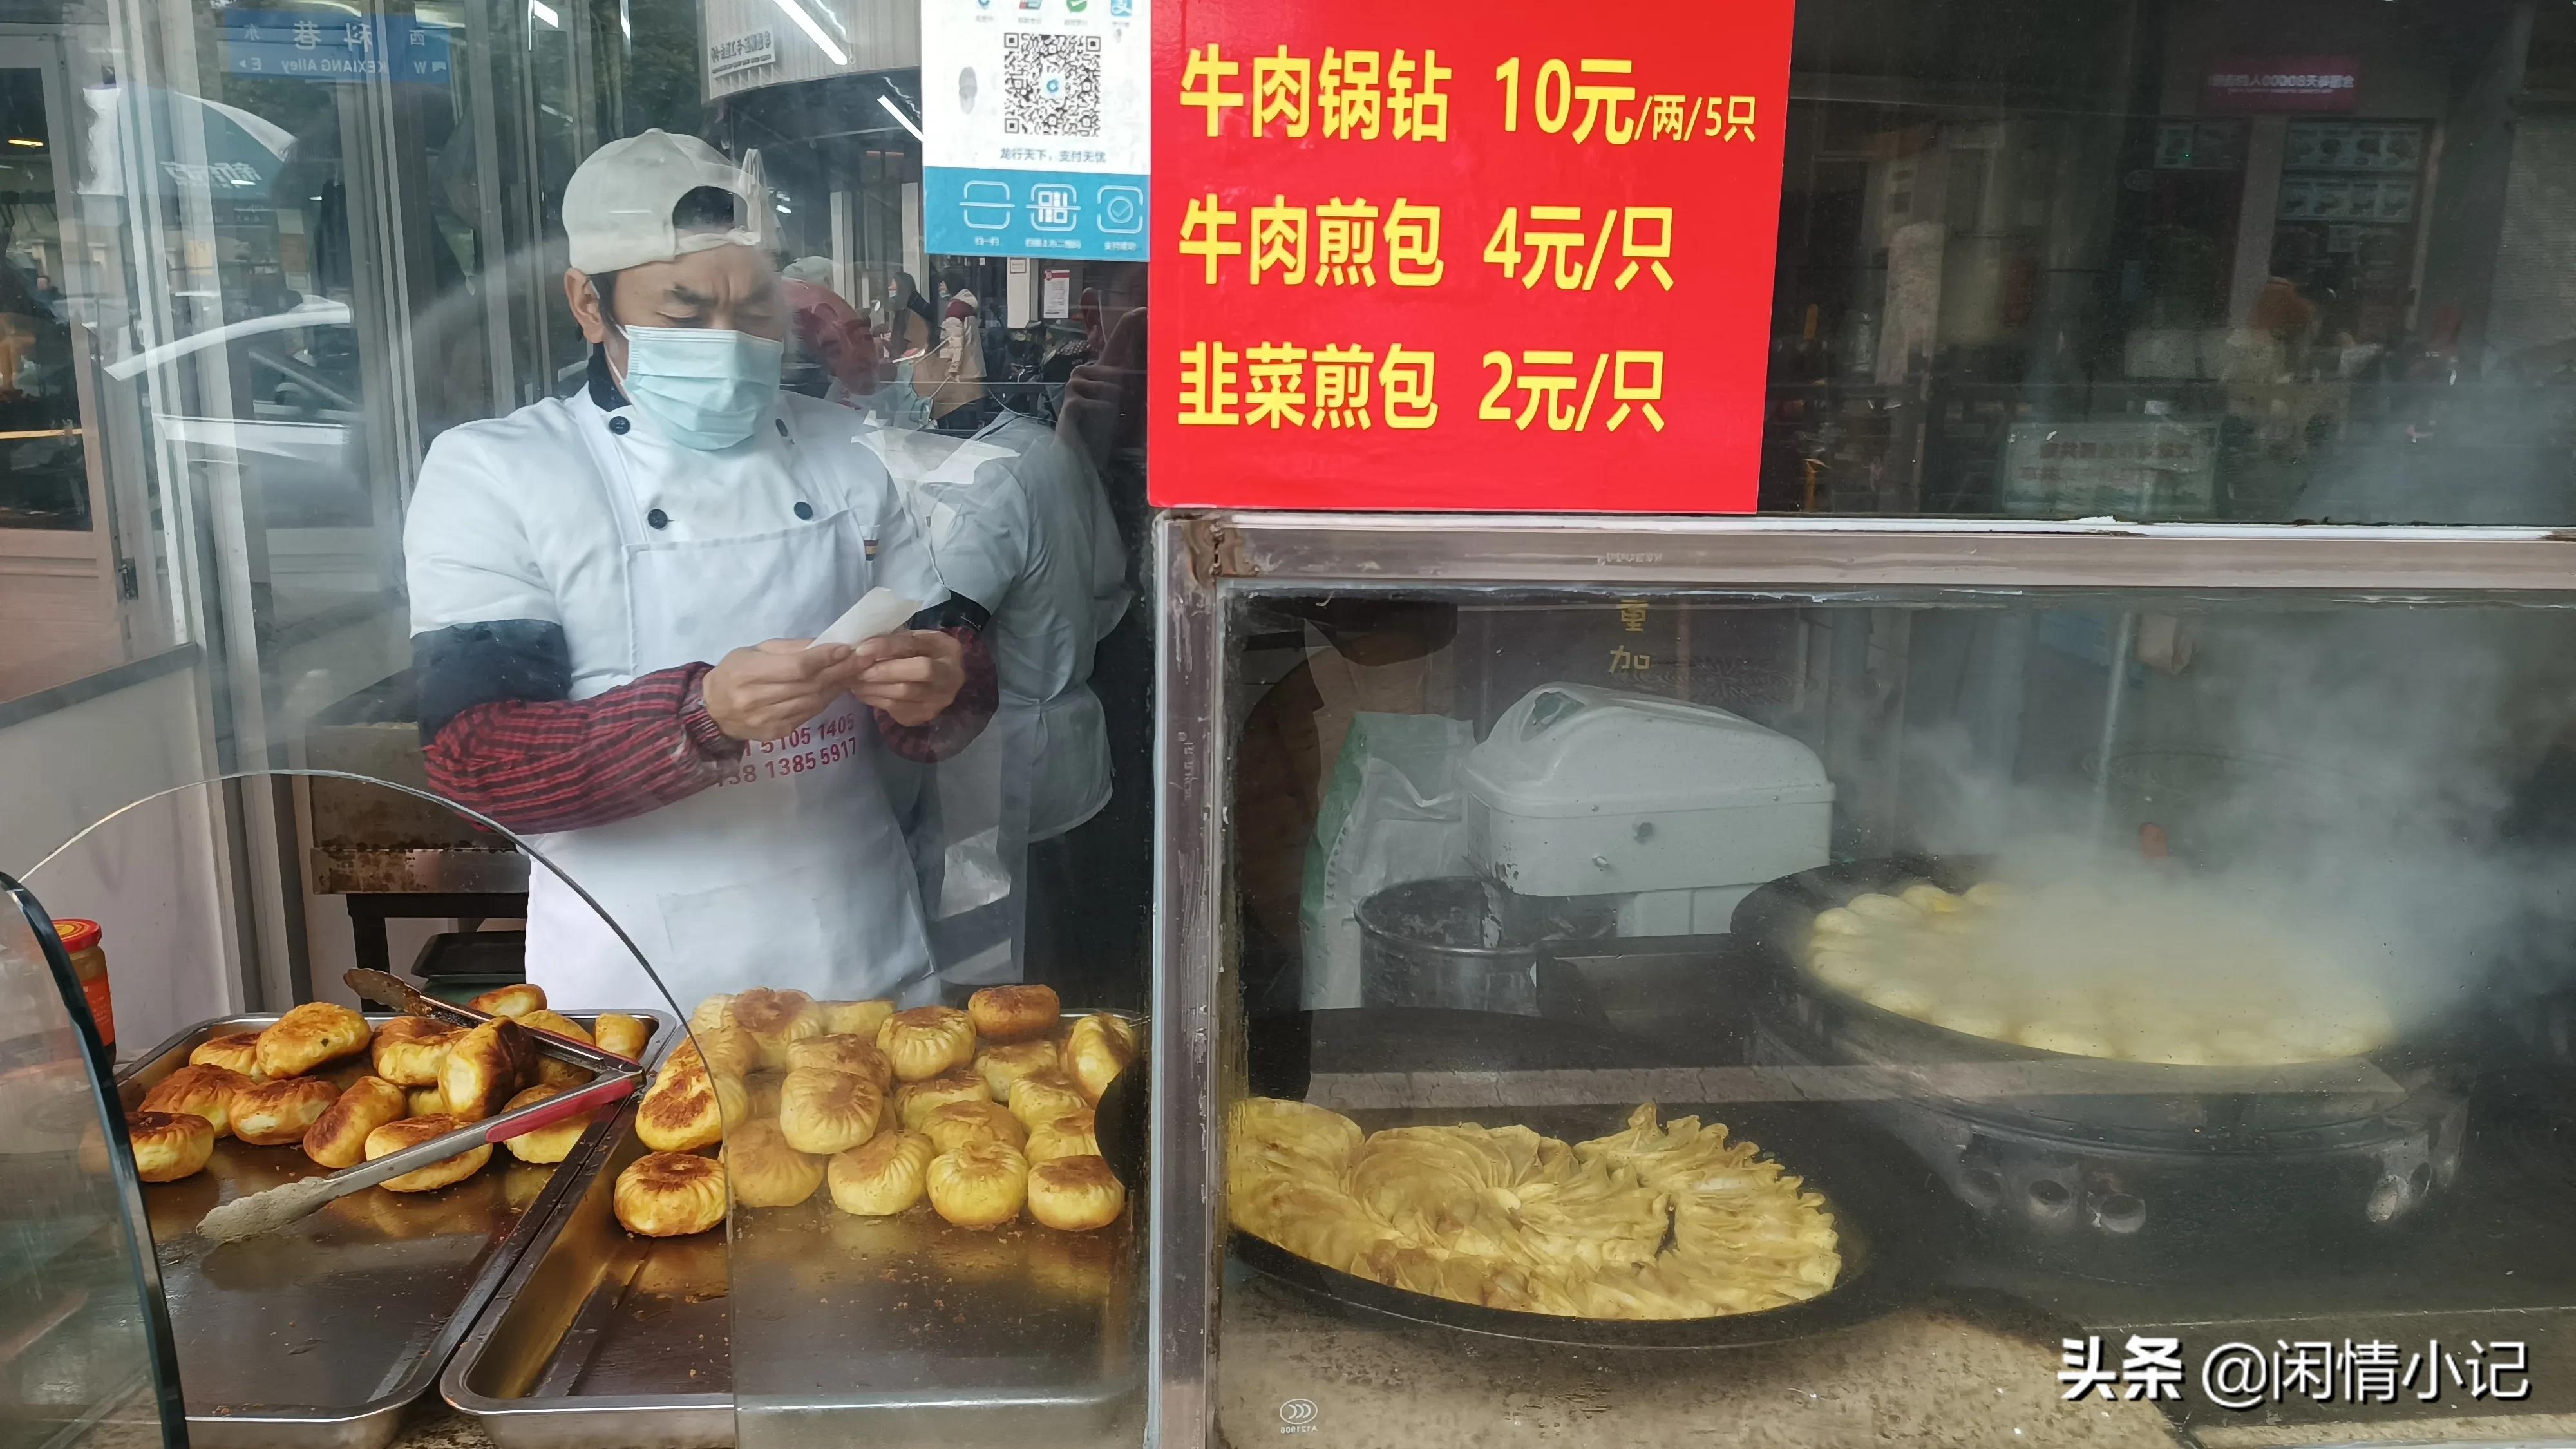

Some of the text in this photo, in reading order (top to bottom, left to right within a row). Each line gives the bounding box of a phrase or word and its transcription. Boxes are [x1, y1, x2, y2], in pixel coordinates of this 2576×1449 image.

[1179, 43, 1453, 143] 牛肉锅钻
[1179, 193, 1674, 292] 牛肉煎包 4元/只
[1177, 341, 1665, 433] 韭菜煎包 2元/只
[719, 736, 856, 787] 38 1385 5917
[761, 726, 811, 754] 5105
[817, 713, 855, 740] 1405
